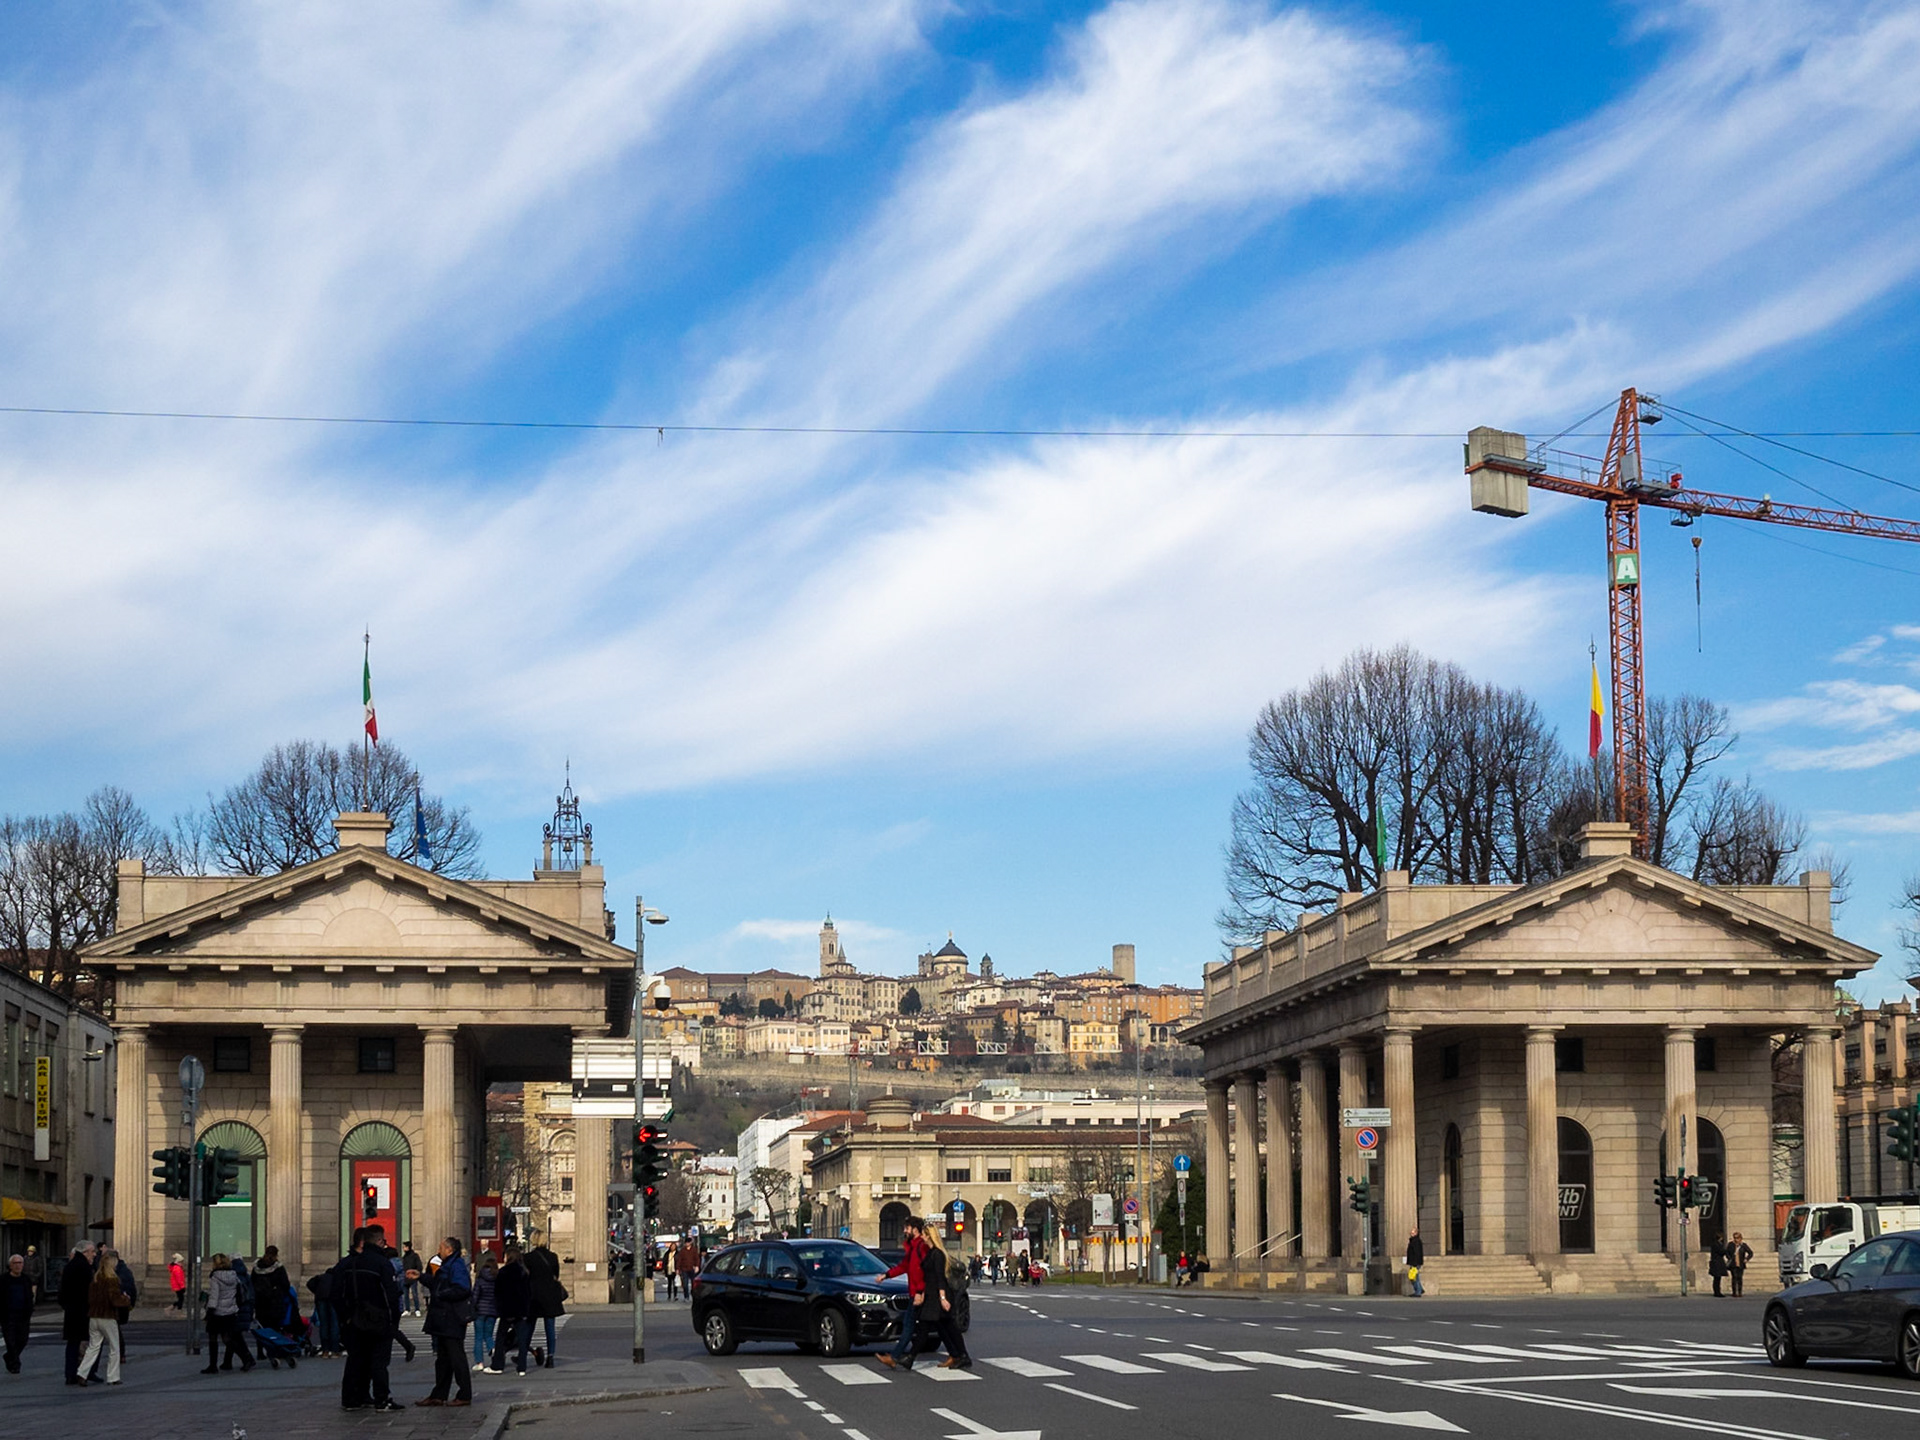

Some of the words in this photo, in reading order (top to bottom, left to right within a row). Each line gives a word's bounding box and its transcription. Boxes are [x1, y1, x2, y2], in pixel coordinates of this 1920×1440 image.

[1617, 557, 1638, 580] A
[38, 1058, 48, 1077] BAR
[37, 1084, 48, 1128] TURISMO
